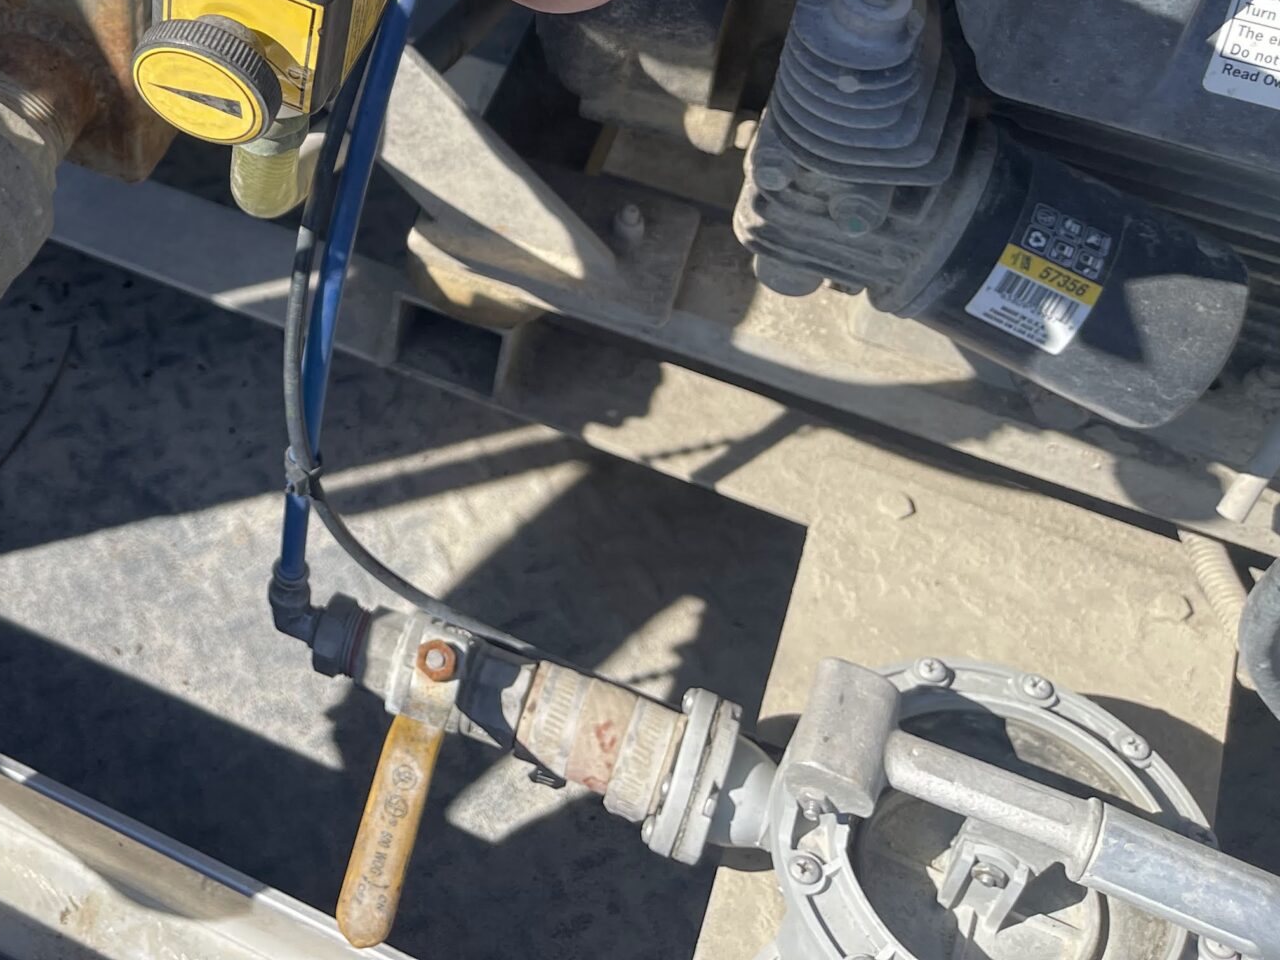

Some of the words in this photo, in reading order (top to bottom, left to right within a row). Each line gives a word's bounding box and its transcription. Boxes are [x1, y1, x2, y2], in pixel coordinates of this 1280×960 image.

[1245, 1, 1277, 23] Turn
[1238, 24, 1264, 42] The
[1230, 43, 1251, 60] Do
[1254, 52, 1280, 67] not
[1222, 62, 1261, 83] Read
[1038, 266, 1090, 297] 57356
